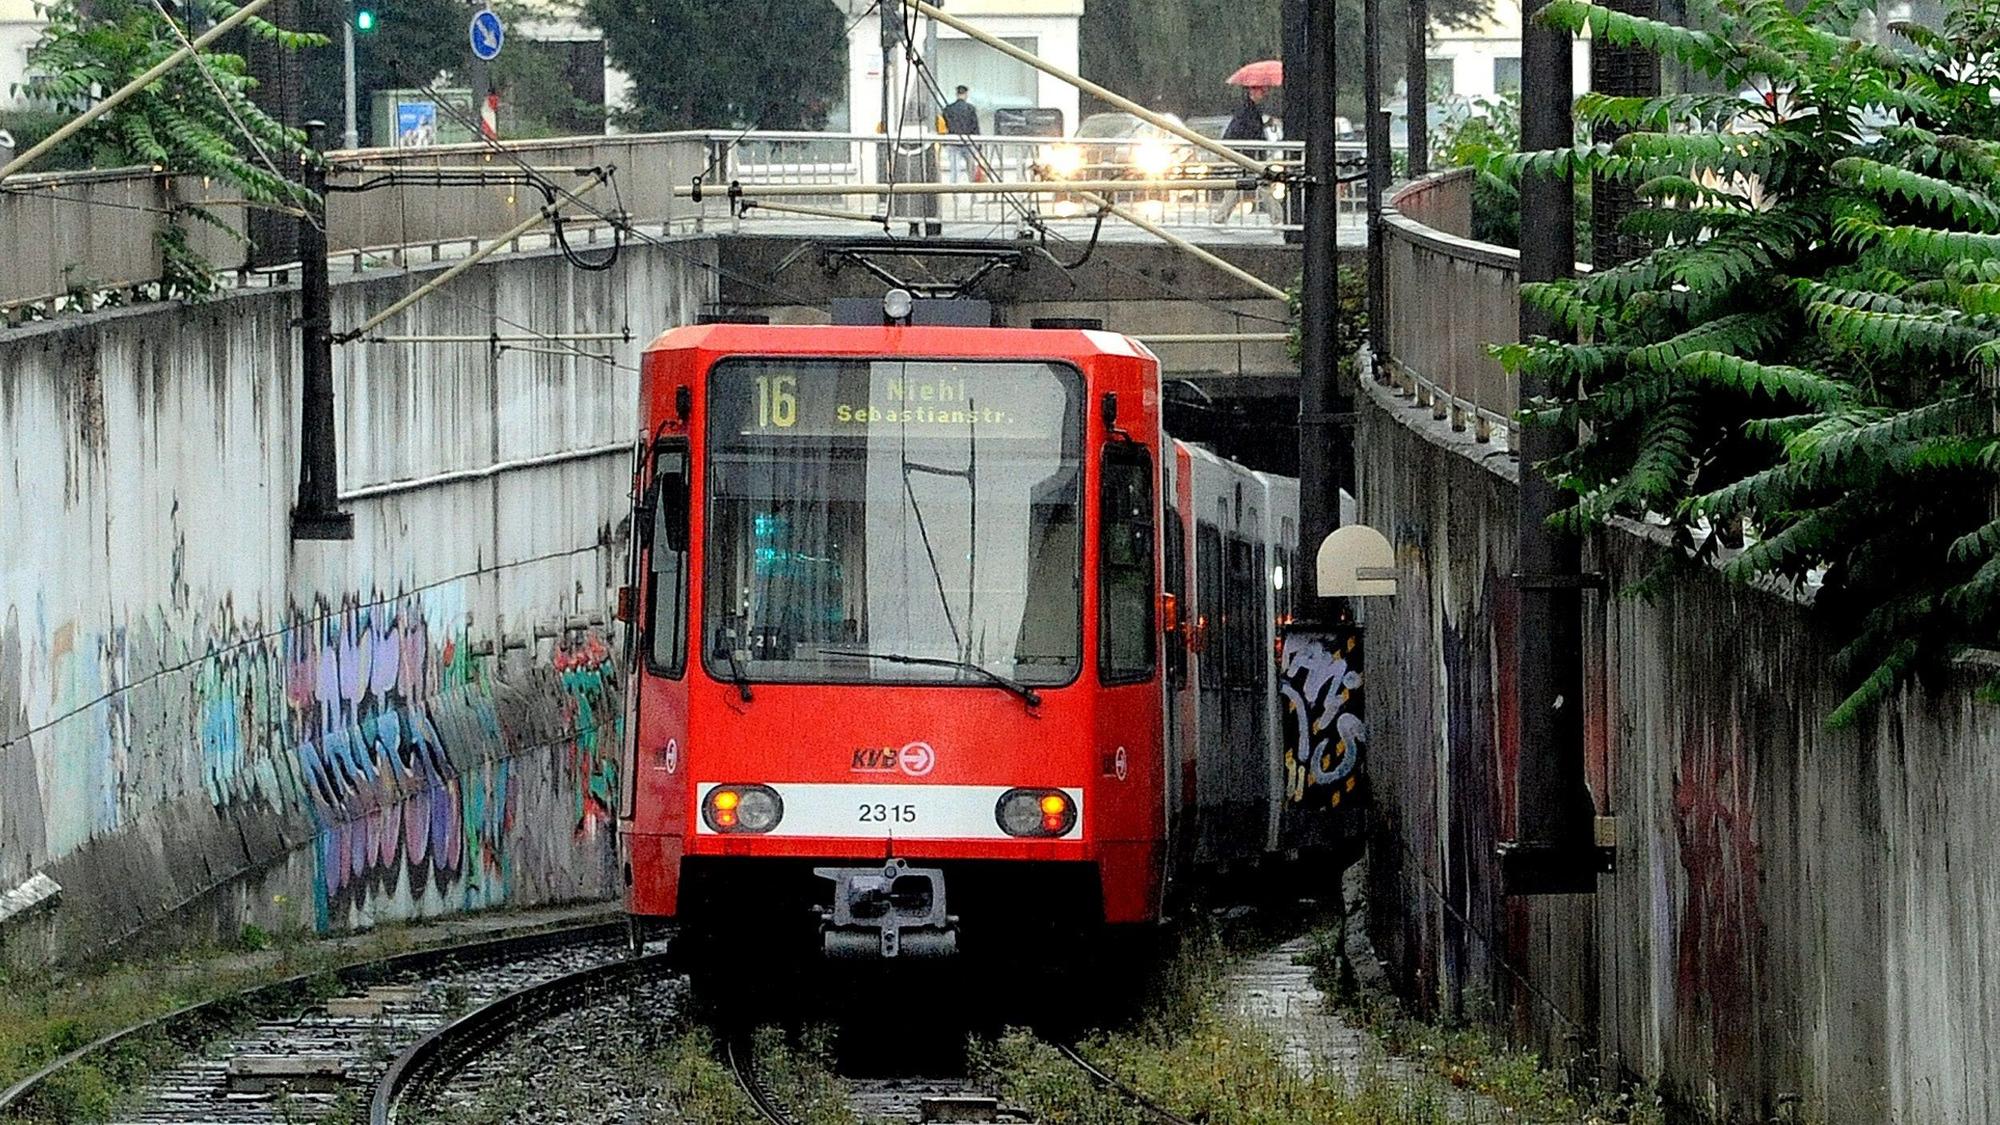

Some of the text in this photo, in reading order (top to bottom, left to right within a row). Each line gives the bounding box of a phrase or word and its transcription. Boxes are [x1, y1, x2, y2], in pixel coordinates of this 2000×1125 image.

[886, 377, 965, 401] Niehl
[756, 375, 797, 428] 16
[836, 404, 1015, 425] Sebastianstr.
[851, 747, 897, 770] KVB
[859, 804, 916, 823] 2315
